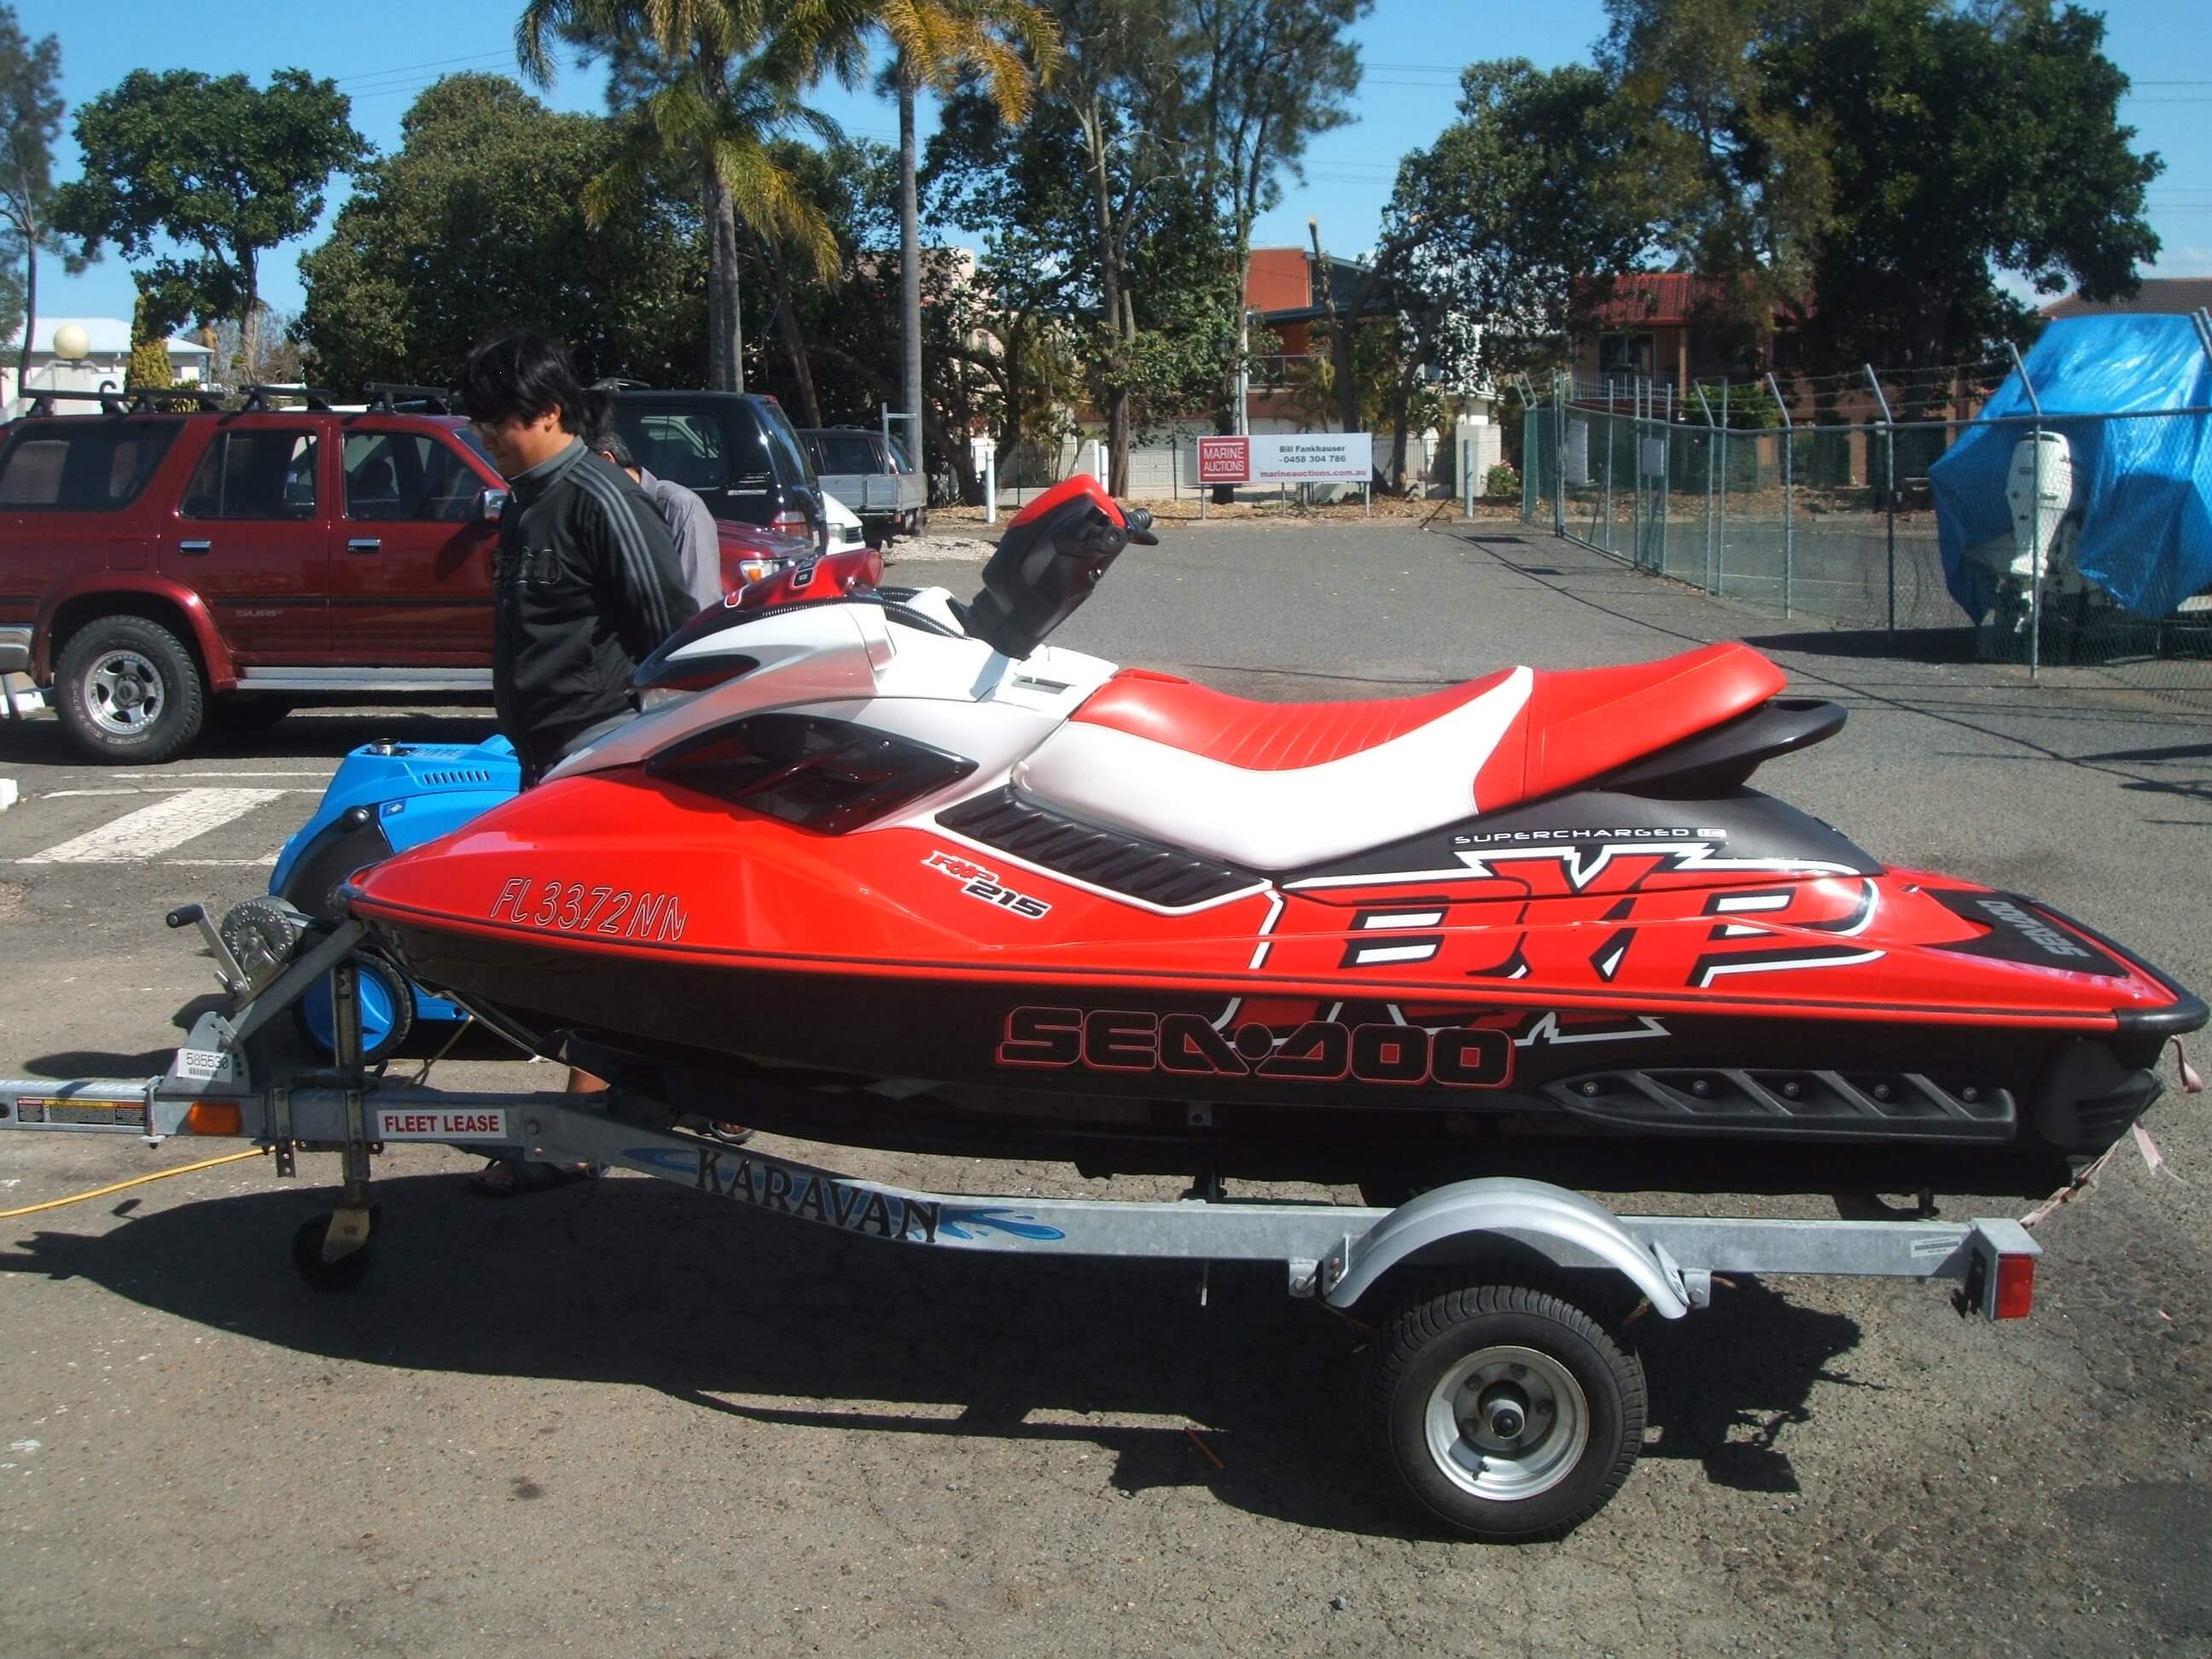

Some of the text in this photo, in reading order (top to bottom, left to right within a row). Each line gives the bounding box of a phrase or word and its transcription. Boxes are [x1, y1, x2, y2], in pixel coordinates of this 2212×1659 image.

[1203, 447, 1244, 459] MARINE
[1203, 461, 1244, 472] AUCTIONS
[1454, 827, 1690, 844] SUPERCHARGED
[490, 878, 532, 923] FL
[964, 879, 1051, 918] 215
[384, 1115, 500, 1132] FLEET LEASE
[696, 1148, 942, 1243] KARAVAN
